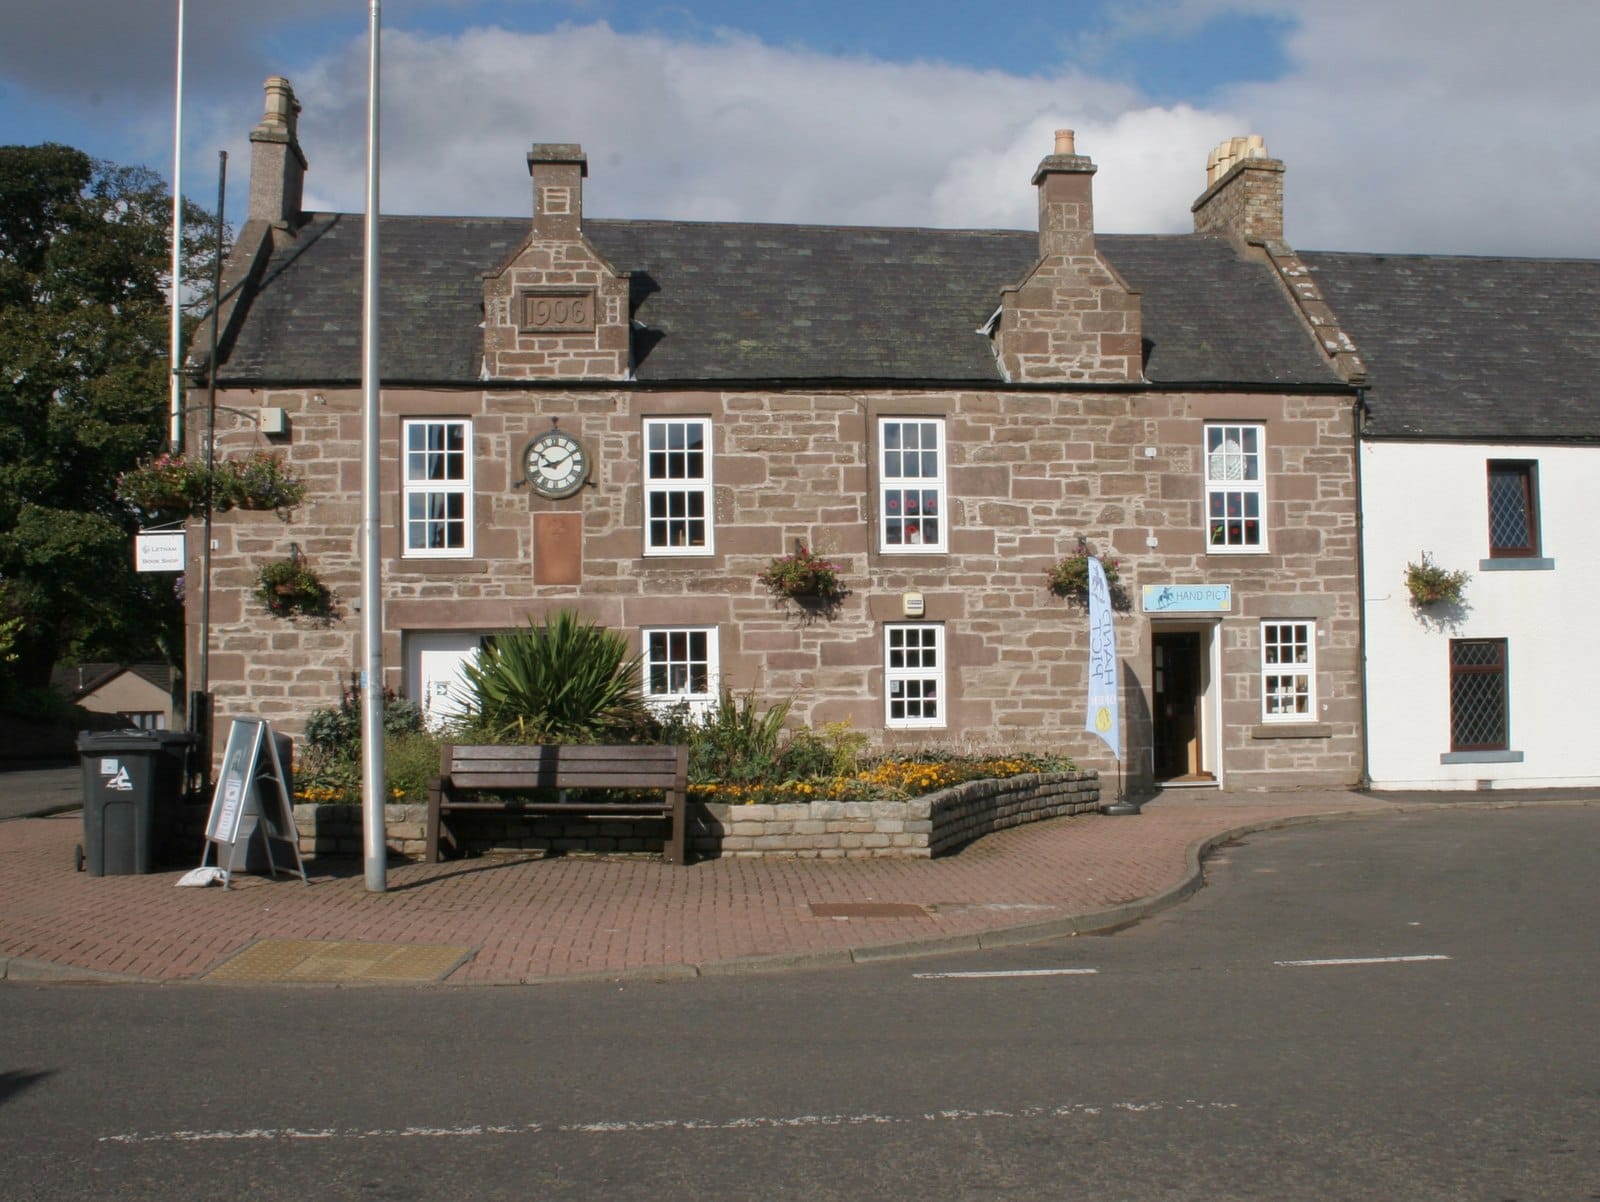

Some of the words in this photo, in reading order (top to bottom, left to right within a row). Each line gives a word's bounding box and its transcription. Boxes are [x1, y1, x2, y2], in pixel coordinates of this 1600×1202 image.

[527, 300, 586, 326] 1906
[1176, 591, 1203, 601] HAND
[1206, 590, 1227, 601] PICT
